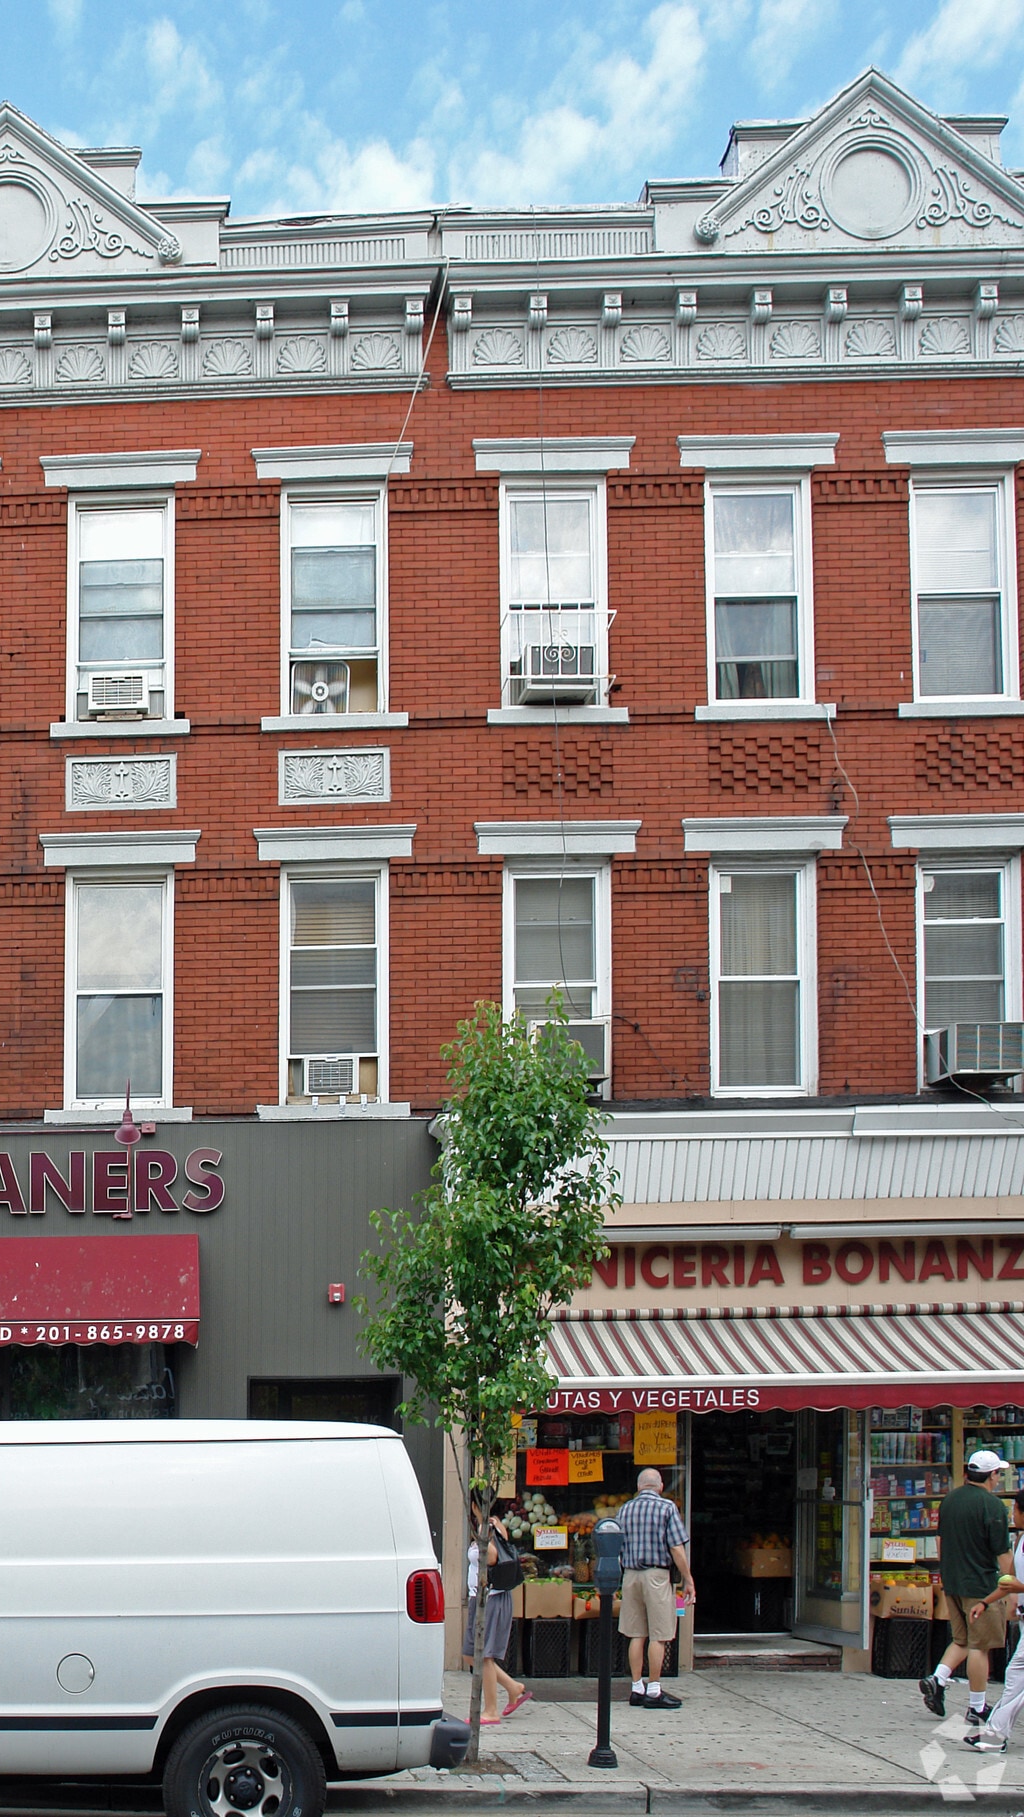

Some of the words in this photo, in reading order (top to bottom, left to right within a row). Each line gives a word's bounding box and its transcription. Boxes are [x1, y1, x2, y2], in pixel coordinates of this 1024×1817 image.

[576, 1246, 785, 1288] NICERIA
[35, 1324, 185, 1341] 201-865-9878
[531, 1390, 601, 1408] UTAS
[608, 1391, 622, 1407] Y
[632, 1389, 760, 1408] VEGETALES
[890, 1605, 929, 1615] Sunkist
[211, 1727, 276, 1746] FUTURA
